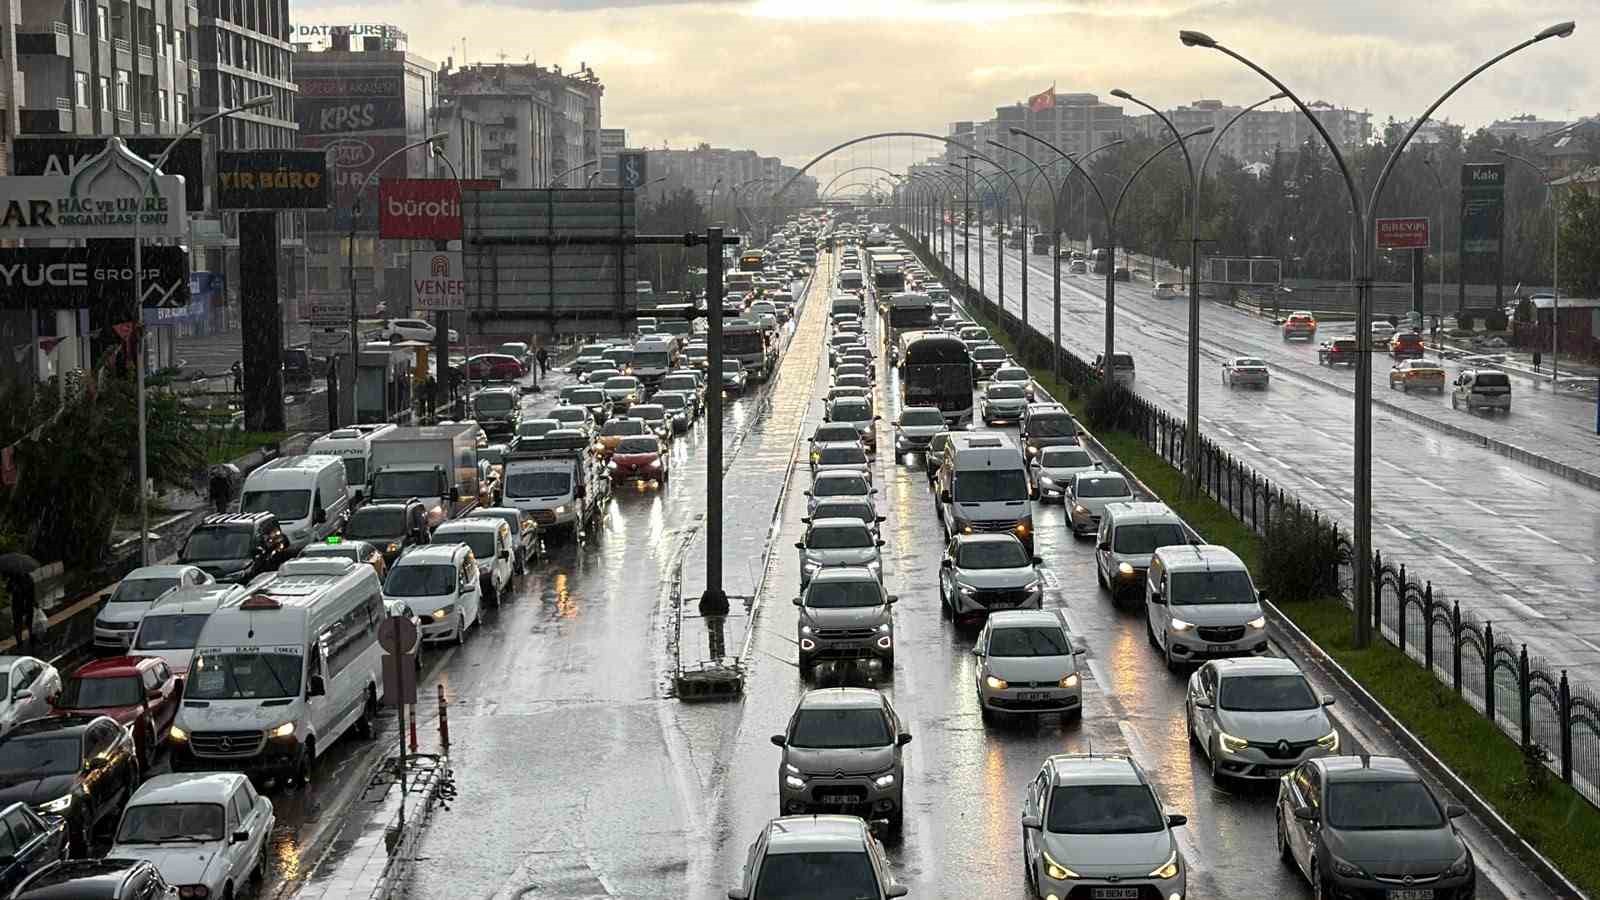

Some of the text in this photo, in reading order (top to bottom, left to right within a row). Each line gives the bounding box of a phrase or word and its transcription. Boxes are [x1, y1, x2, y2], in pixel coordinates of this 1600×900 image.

[320, 104, 374, 130] KPSS
[260, 166, 321, 190] BÜRO
[388, 197, 462, 217] büroti
